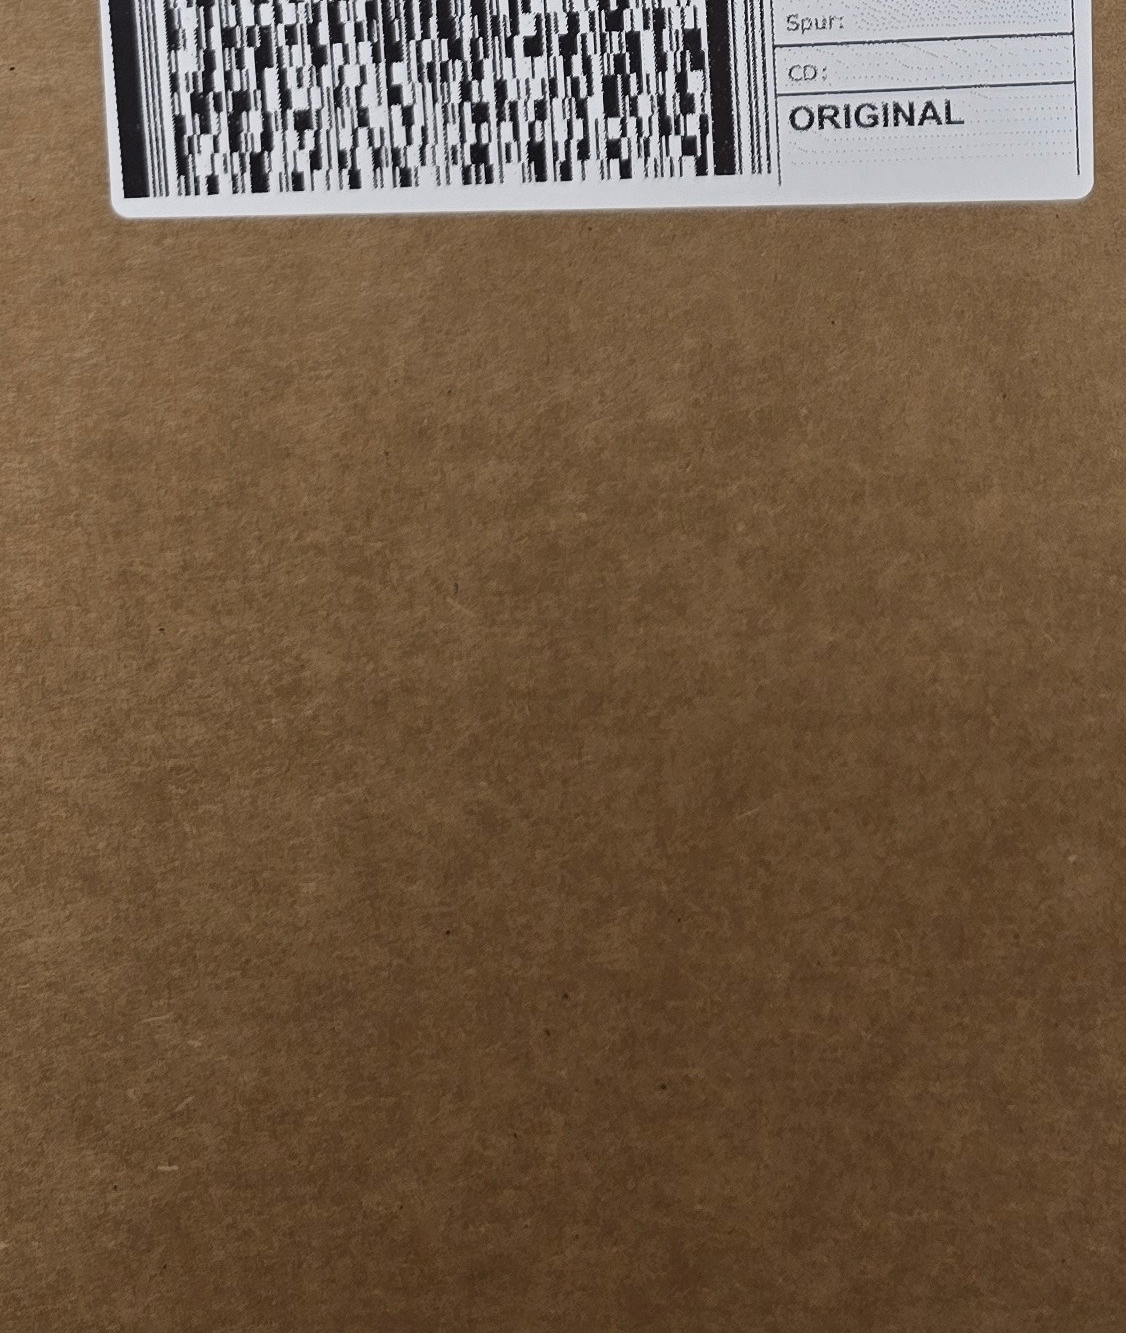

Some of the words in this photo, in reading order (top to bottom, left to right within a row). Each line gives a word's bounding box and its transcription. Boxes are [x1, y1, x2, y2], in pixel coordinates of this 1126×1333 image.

[786, 14, 844, 35] Spur:
[788, 64, 828, 81] CD:
[788, 99, 965, 131] ORIGINAL
